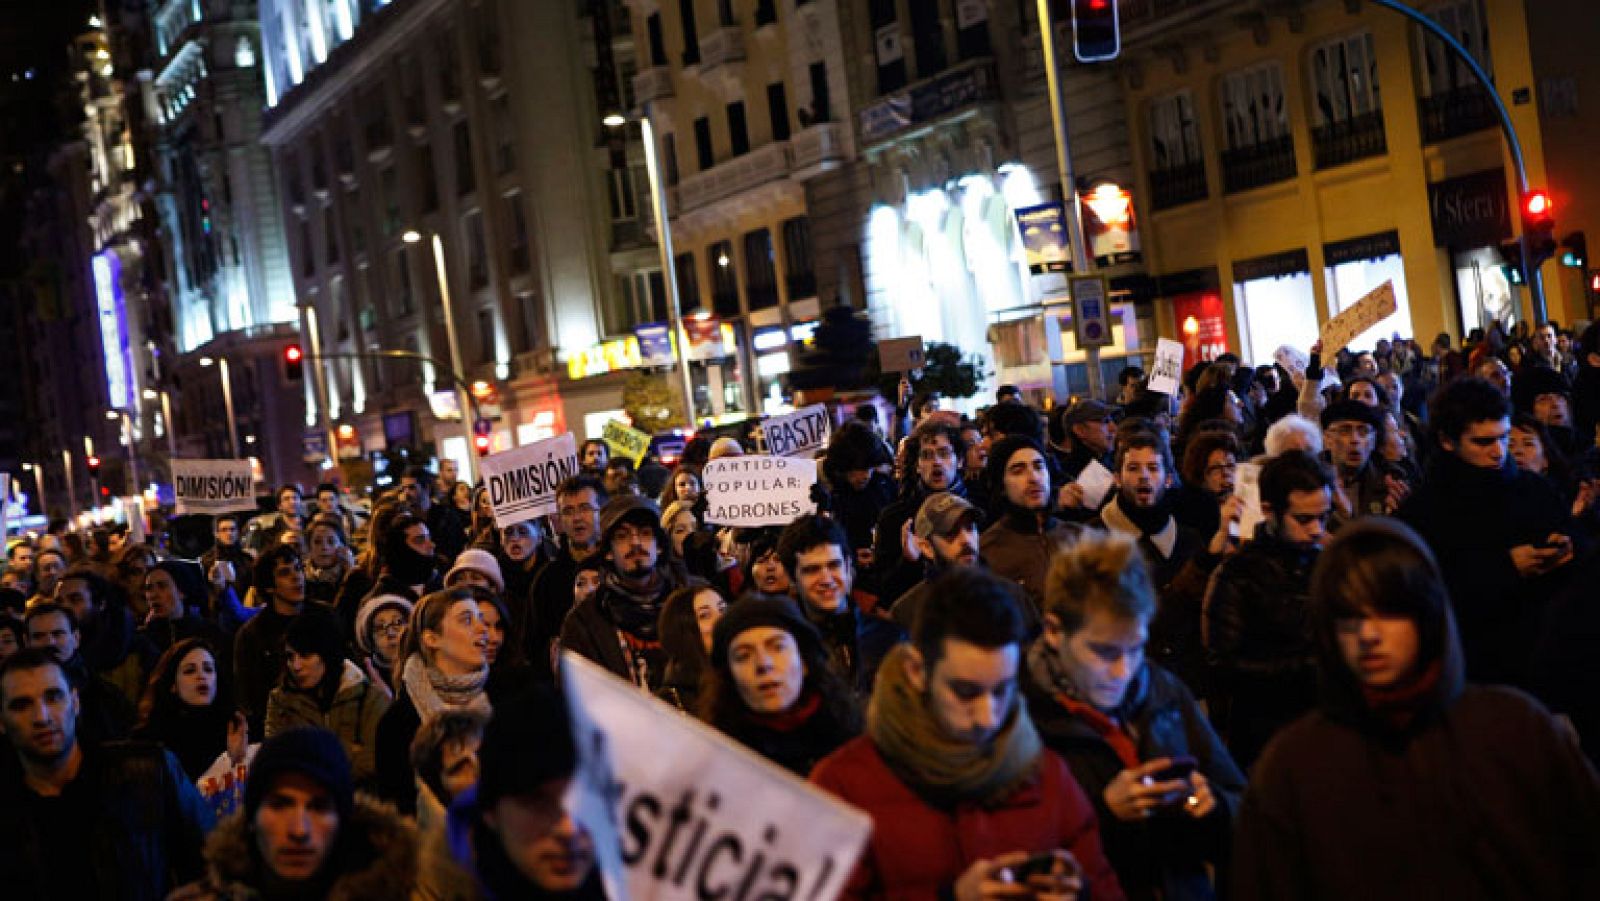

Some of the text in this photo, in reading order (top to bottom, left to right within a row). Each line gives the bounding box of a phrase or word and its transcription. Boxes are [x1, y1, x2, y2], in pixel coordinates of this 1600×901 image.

[705, 458, 787, 475] PARTIDO
[176, 470, 251, 499] DIMISIÓN!
[704, 477, 801, 503] POPULAR:
[707, 500, 801, 520] LADRONES
